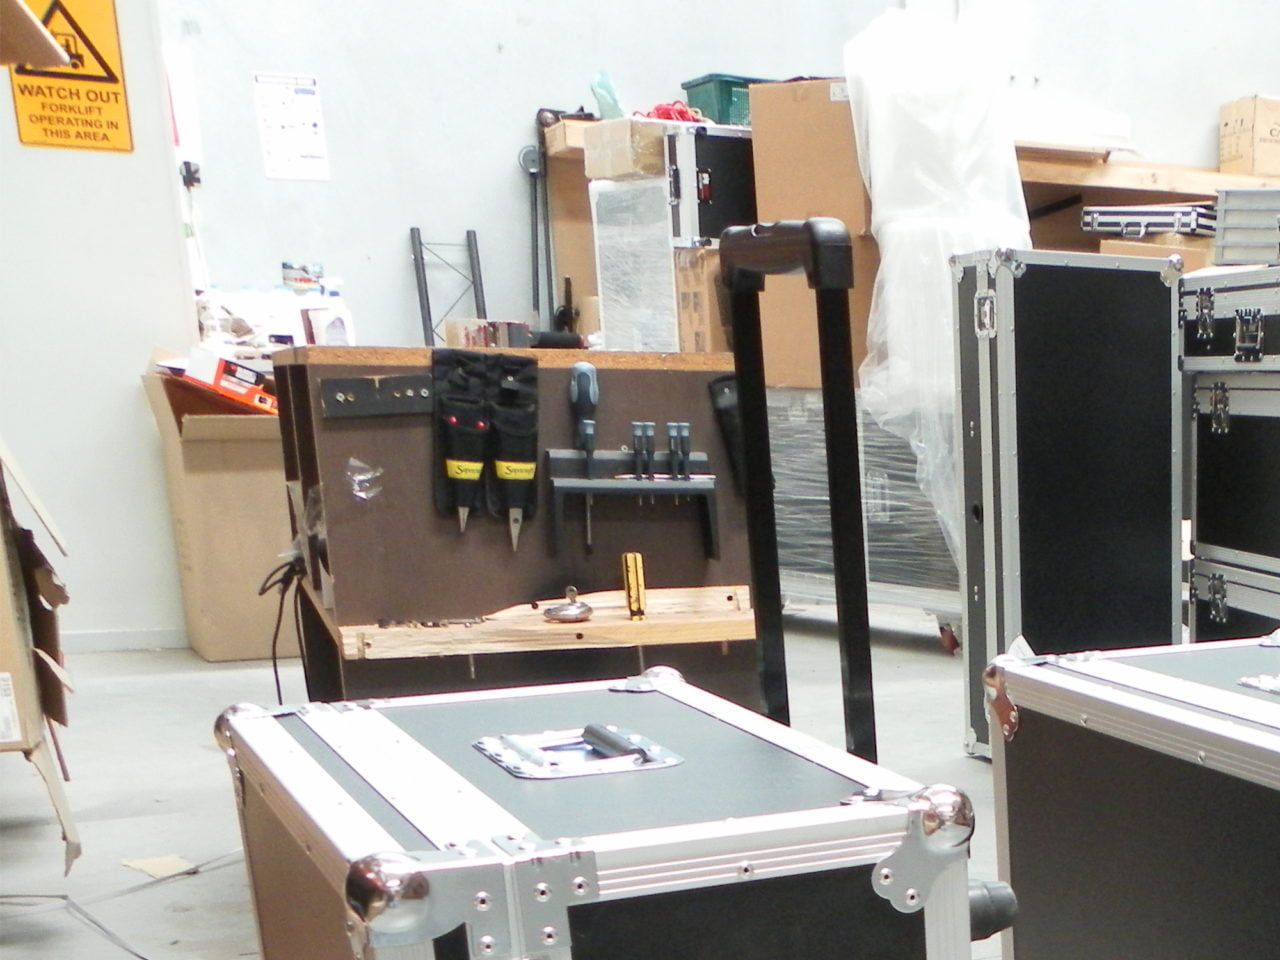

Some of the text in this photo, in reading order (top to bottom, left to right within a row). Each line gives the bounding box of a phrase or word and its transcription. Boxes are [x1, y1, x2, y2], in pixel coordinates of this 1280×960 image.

[17, 83, 120, 104] WATCH OUT
[41, 102, 103, 116] FORKLIFT
[28, 114, 119, 130] OPERATING IN
[42, 128, 110, 142] THIS AREA
